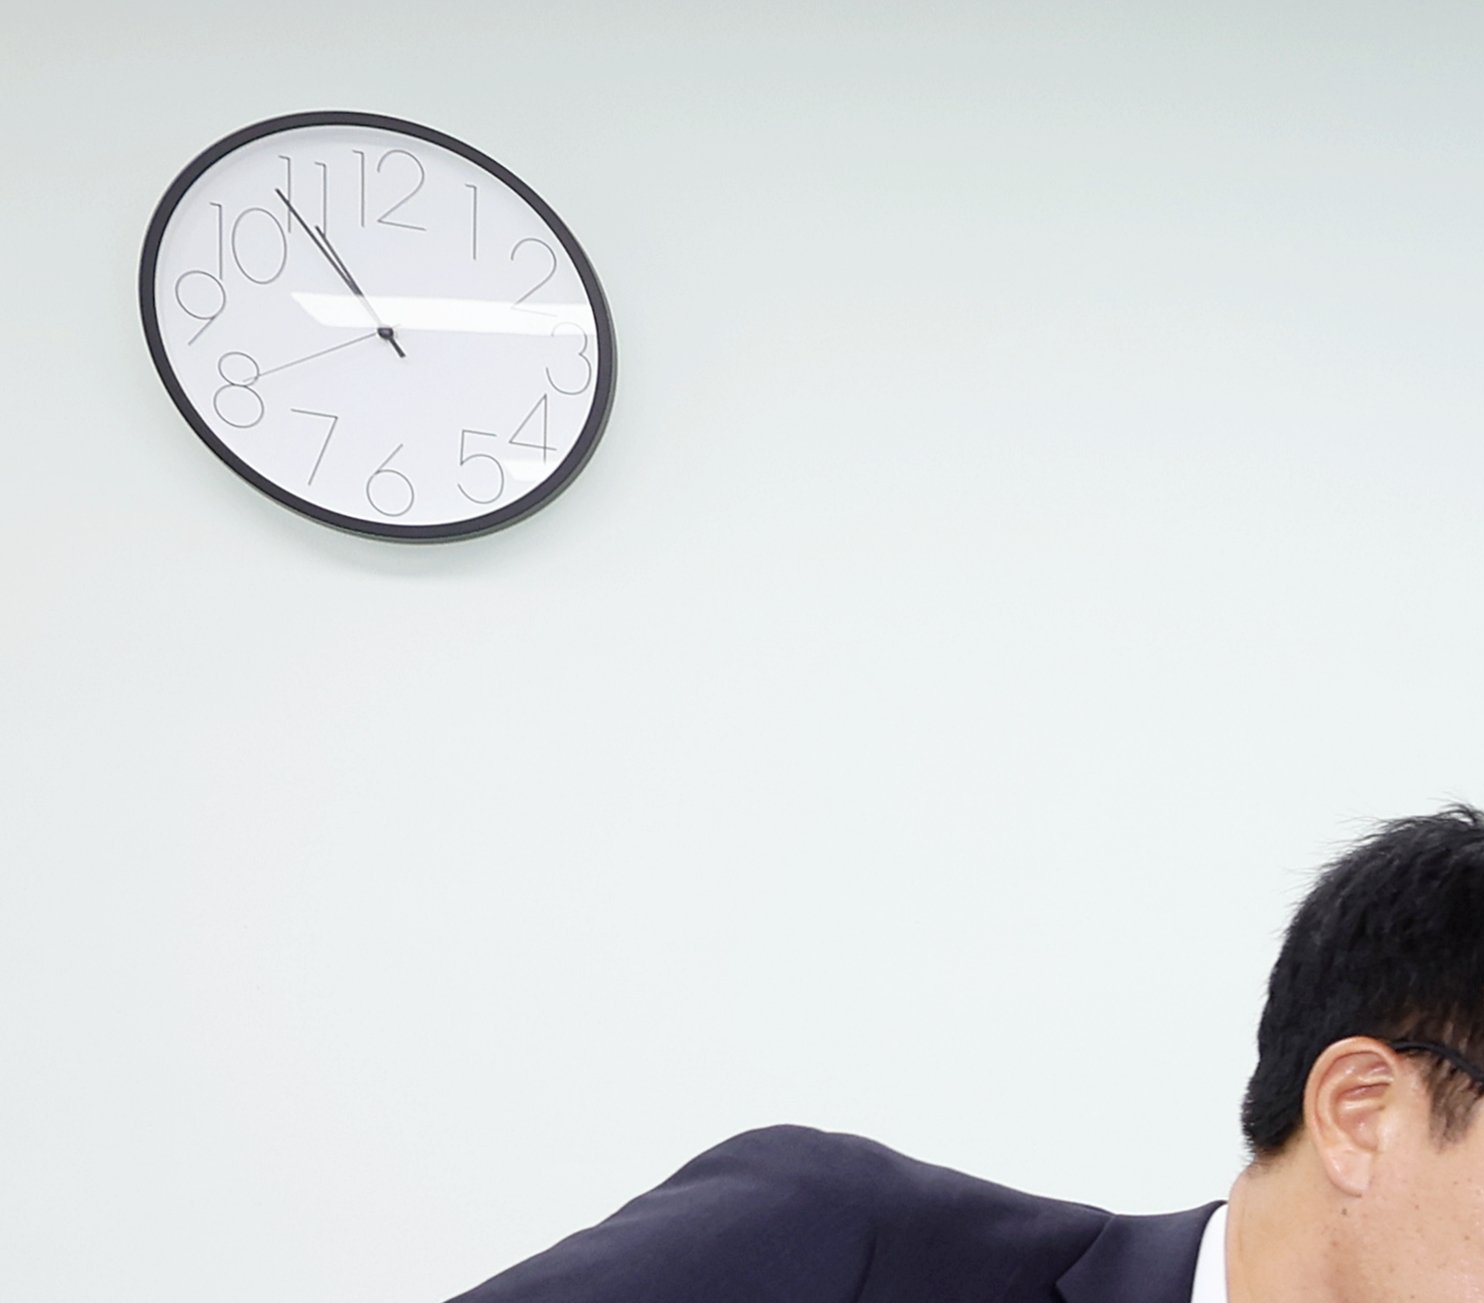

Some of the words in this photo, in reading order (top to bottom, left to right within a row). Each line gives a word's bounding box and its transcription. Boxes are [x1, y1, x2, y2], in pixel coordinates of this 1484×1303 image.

[278, 155, 328, 238] 11
[352, 148, 427, 231] 12
[464, 184, 478, 261] 1
[208, 202, 288, 285] 10
[510, 237, 558, 318] 2
[175, 269, 226, 346] 9
[212, 351, 265, 429] 8
[545, 321, 592, 395] 3
[290, 408, 339, 486] 7
[457, 428, 505, 504] 5
[508, 393, 558, 465] 4
[366, 443, 415, 518] 6
